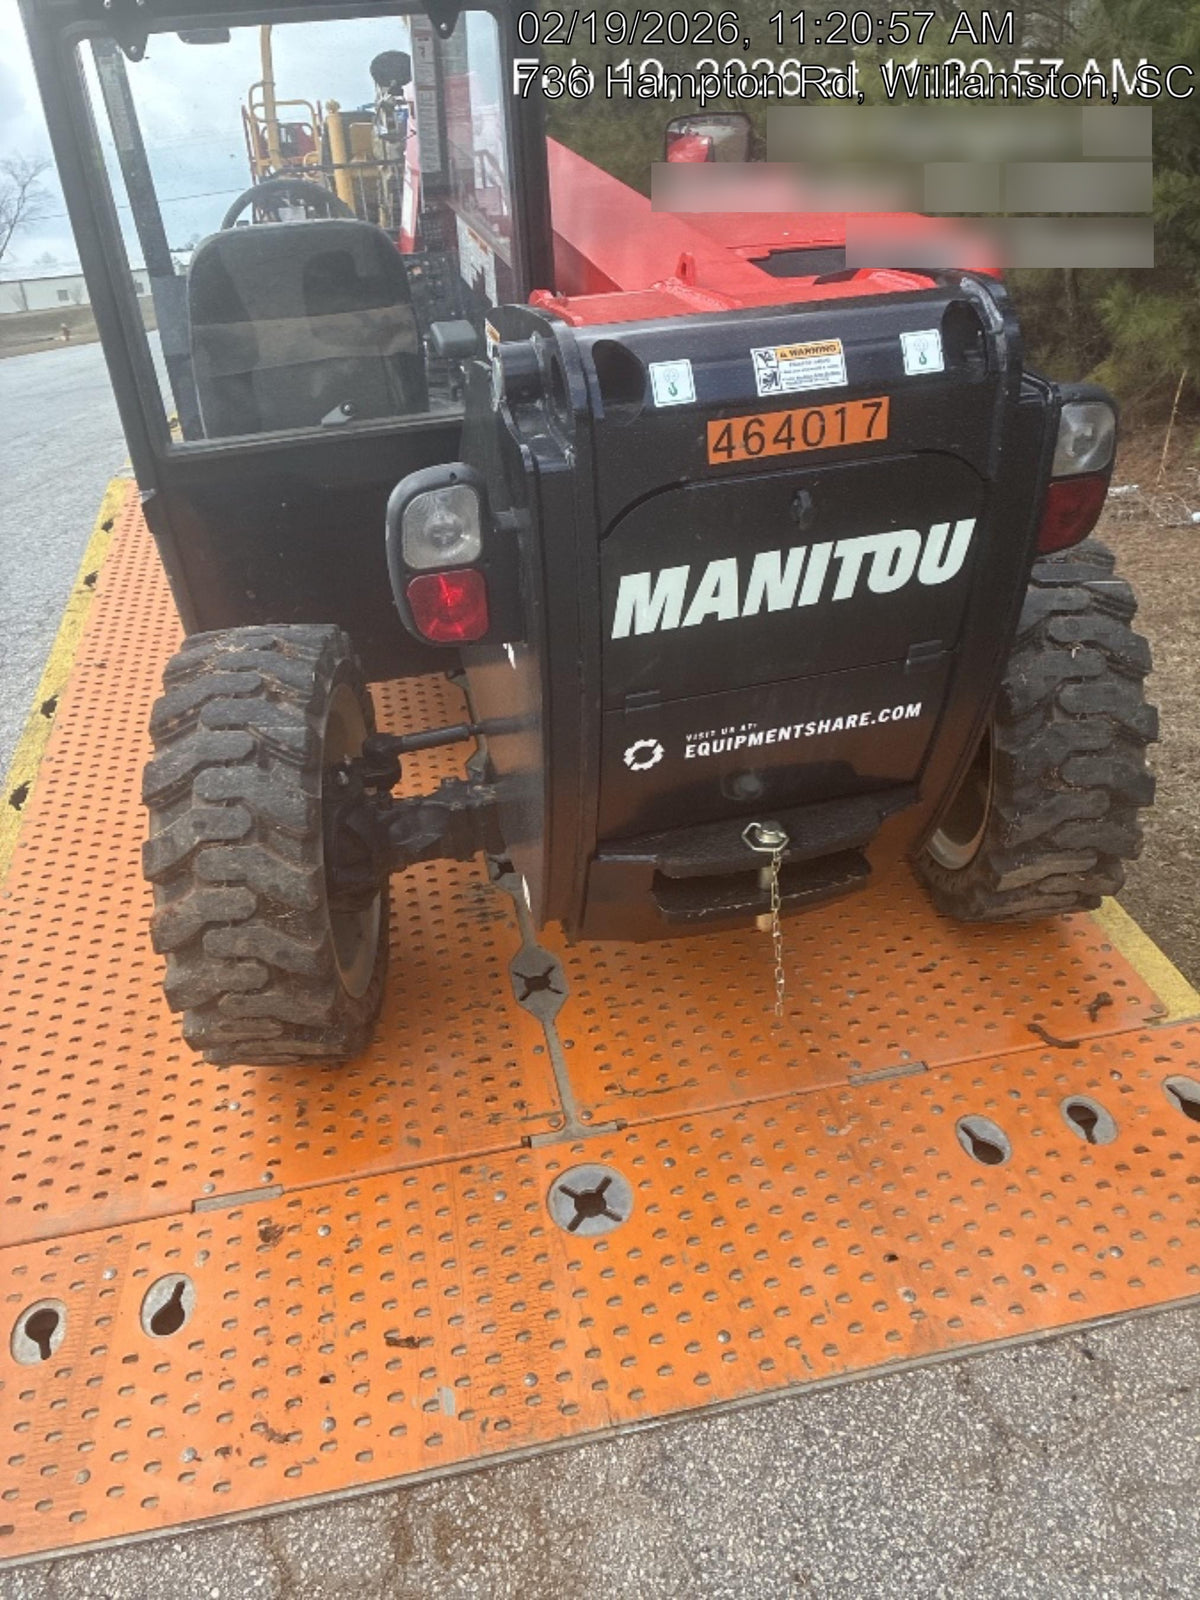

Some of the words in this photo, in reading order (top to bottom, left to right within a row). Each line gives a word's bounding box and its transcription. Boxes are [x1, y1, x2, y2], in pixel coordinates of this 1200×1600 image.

[789, 344, 837, 357] WARNING
[712, 401, 882, 459] 464017
[611, 518, 976, 640] MANITOU
[684, 702, 922, 759] EQUIPMENTSHARE.COM
